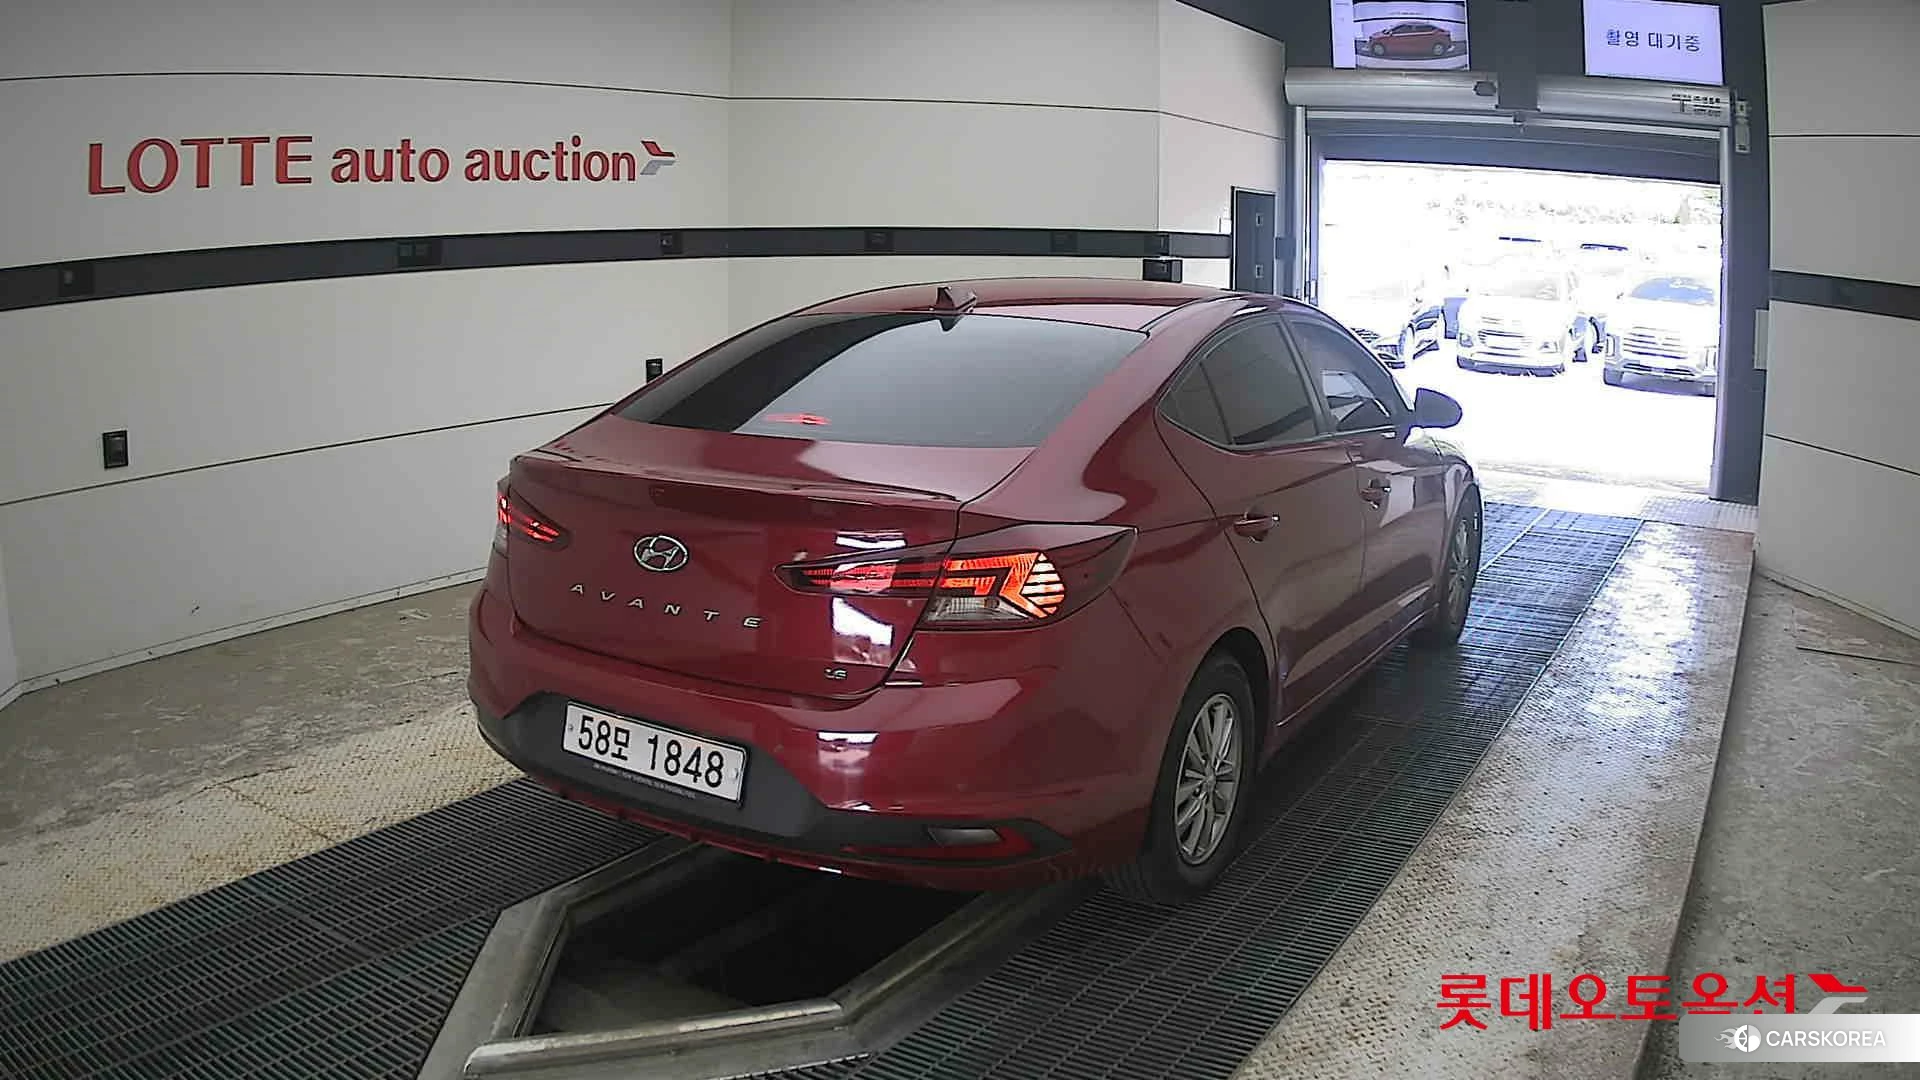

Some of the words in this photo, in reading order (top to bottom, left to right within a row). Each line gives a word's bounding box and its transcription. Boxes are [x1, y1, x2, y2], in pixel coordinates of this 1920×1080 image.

[1648, 32, 1701, 52] 대기중
[89, 136, 313, 195] LOTTE
[331, 139, 450, 183] auto
[464, 135, 637, 181] auction
[570, 584, 761, 628] AVANTE
[578, 715, 630, 761] 58모
[647, 735, 724, 788] 1848
